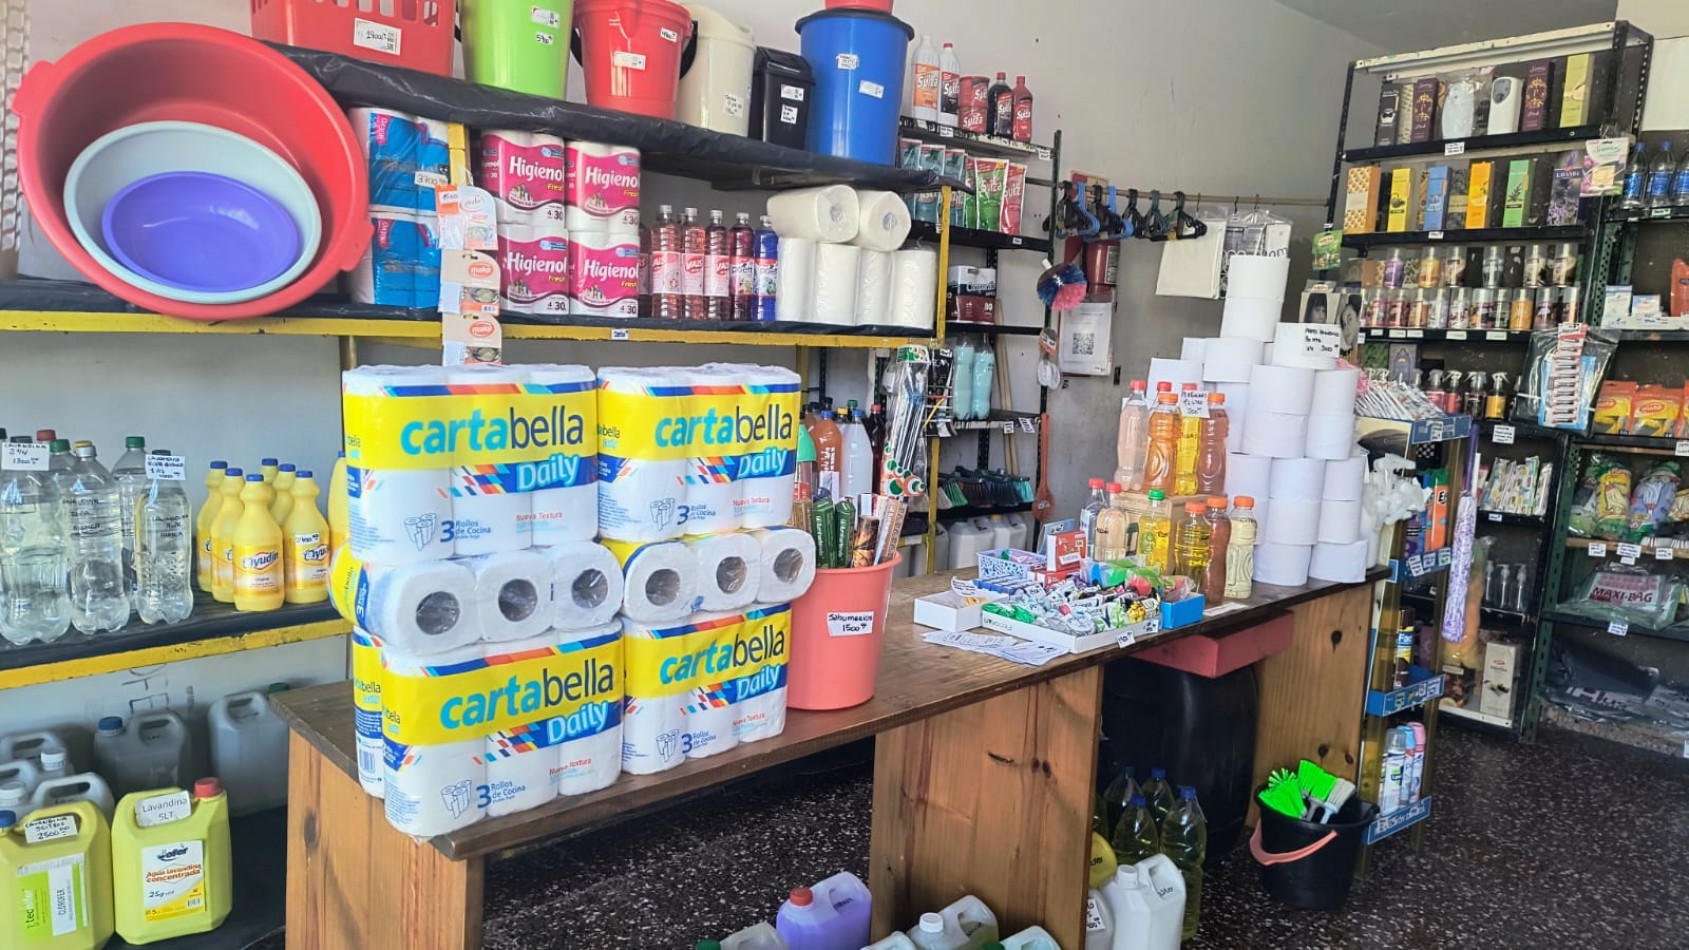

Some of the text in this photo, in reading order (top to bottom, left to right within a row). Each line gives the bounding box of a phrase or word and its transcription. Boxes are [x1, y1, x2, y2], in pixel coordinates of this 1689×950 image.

[585, 166, 640, 189] Higienol
[508, 252, 567, 275] Higienol
[584, 259, 639, 281] Higienol
[555, 301, 566, 311] 30
[627, 305, 637, 314] 30
[400, 407, 584, 456] cartabella
[655, 405, 792, 447] cartabella
[517, 453, 580, 491] Daily
[738, 448, 787, 477] Daily
[456, 520, 479, 528] Rollos
[677, 505, 690, 525] 3
[440, 520, 455, 543] 3
[456, 526, 492, 535] de Cocina
[660, 625, 785, 685] cartabella
[440, 658, 614, 729] cartabella
[737, 665, 781, 702] Daily
[548, 701, 608, 745] Daily
[681, 734, 693, 754] 3
[491, 780, 513, 790] Rollos
[492, 784, 526, 799] de Cocina
[142, 797, 188, 813] Lavandina
[476, 785, 491, 808] 3
[146, 870, 165, 878] Agua
[146, 870, 201, 883] concentrada
